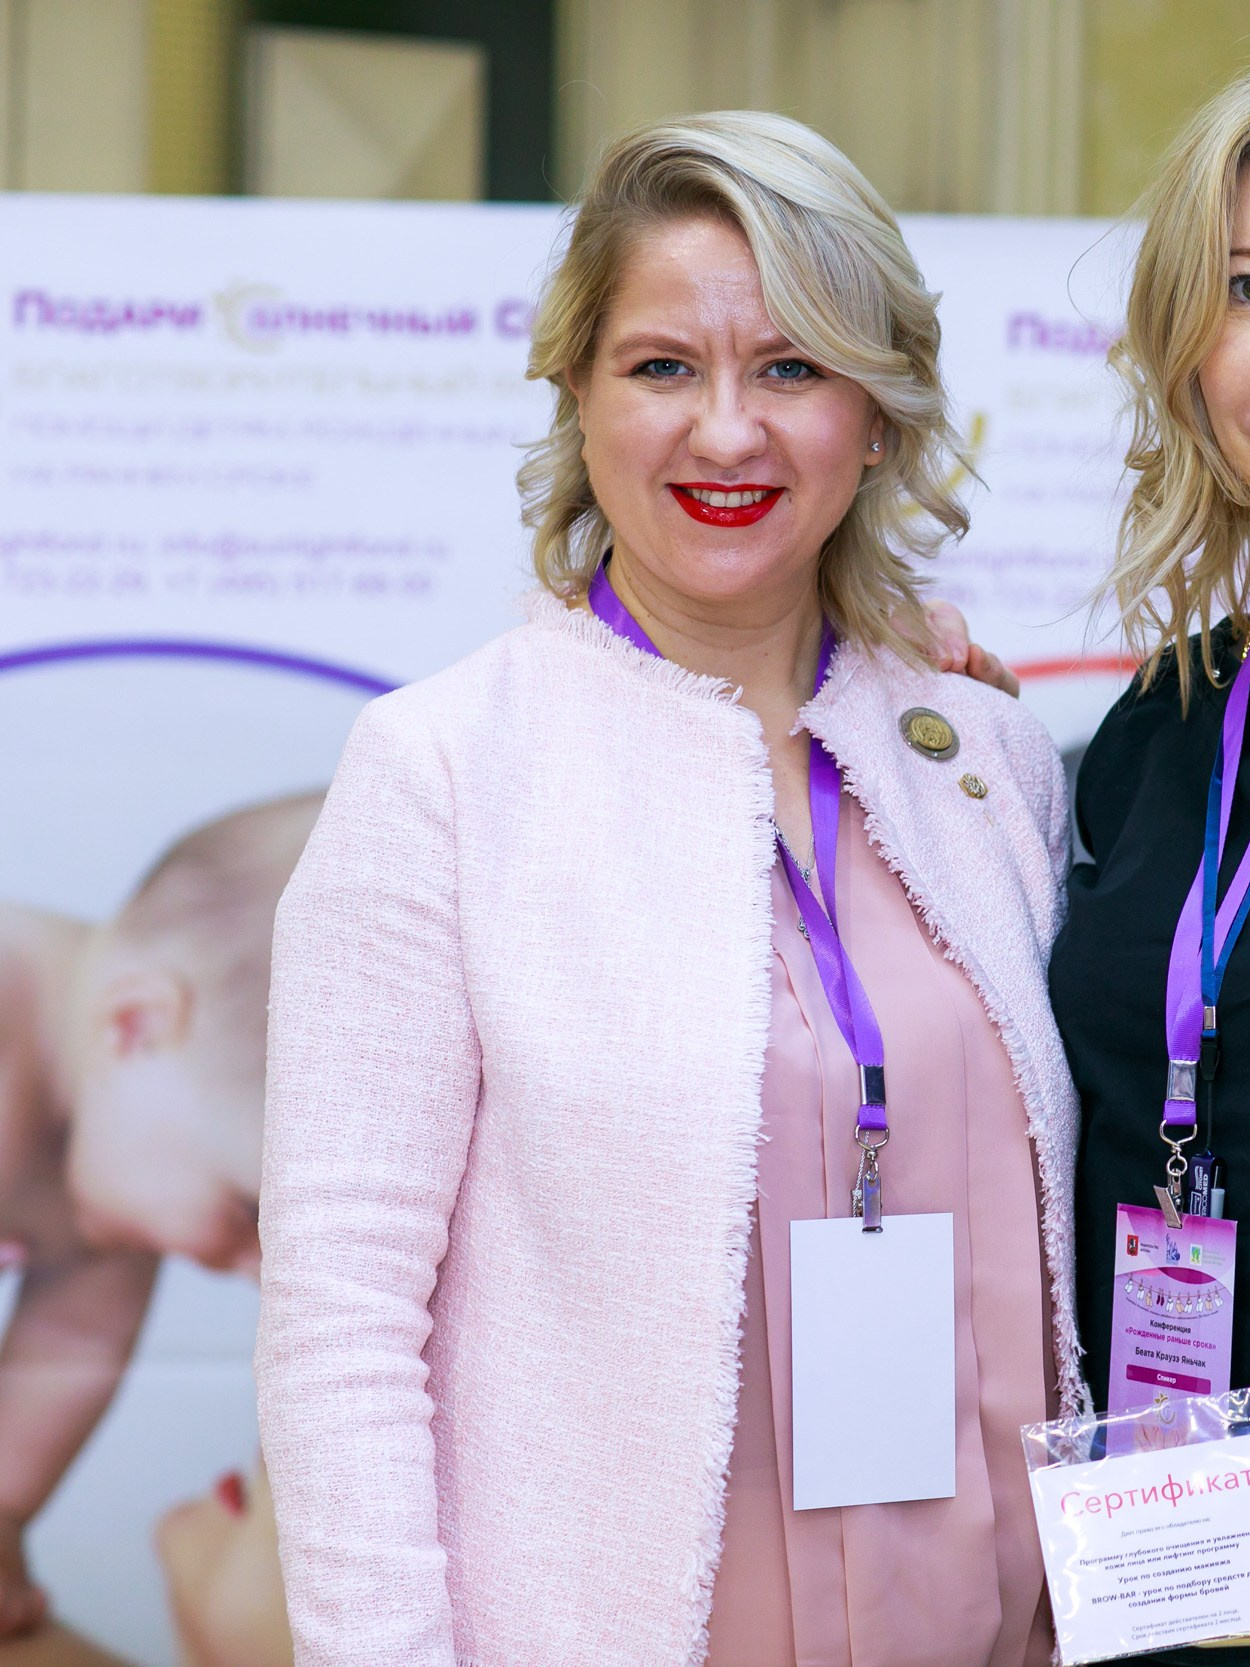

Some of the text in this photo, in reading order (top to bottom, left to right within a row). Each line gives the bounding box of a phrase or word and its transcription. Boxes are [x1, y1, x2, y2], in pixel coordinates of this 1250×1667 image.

[1125, 1326, 1217, 1350] «Рожденные раньше срока»
[1149, 1319, 1191, 1334] Конференция
[1135, 1346, 1206, 1368] Беата Краузэ Яньчак
[1156, 1373, 1177, 1384] Спикер
[1079, 1553, 1124, 1567] Программу
[1124, 1547, 1164, 1559] глубокого
[1165, 1539, 1205, 1551] очищения
[1104, 1542, 1240, 1571] кожи лица или лифтинг программу
[1117, 1559, 1231, 1585] Урок по созданию макияжа
[1091, 1590, 1137, 1605] BROW-BAR
[1143, 1586, 1162, 1597] урок
[1164, 1584, 1175, 1592] по
[1176, 1577, 1212, 1591] подбору
[1213, 1572, 1245, 1586] средств
[1128, 1584, 1230, 1608] создания формы бровей
